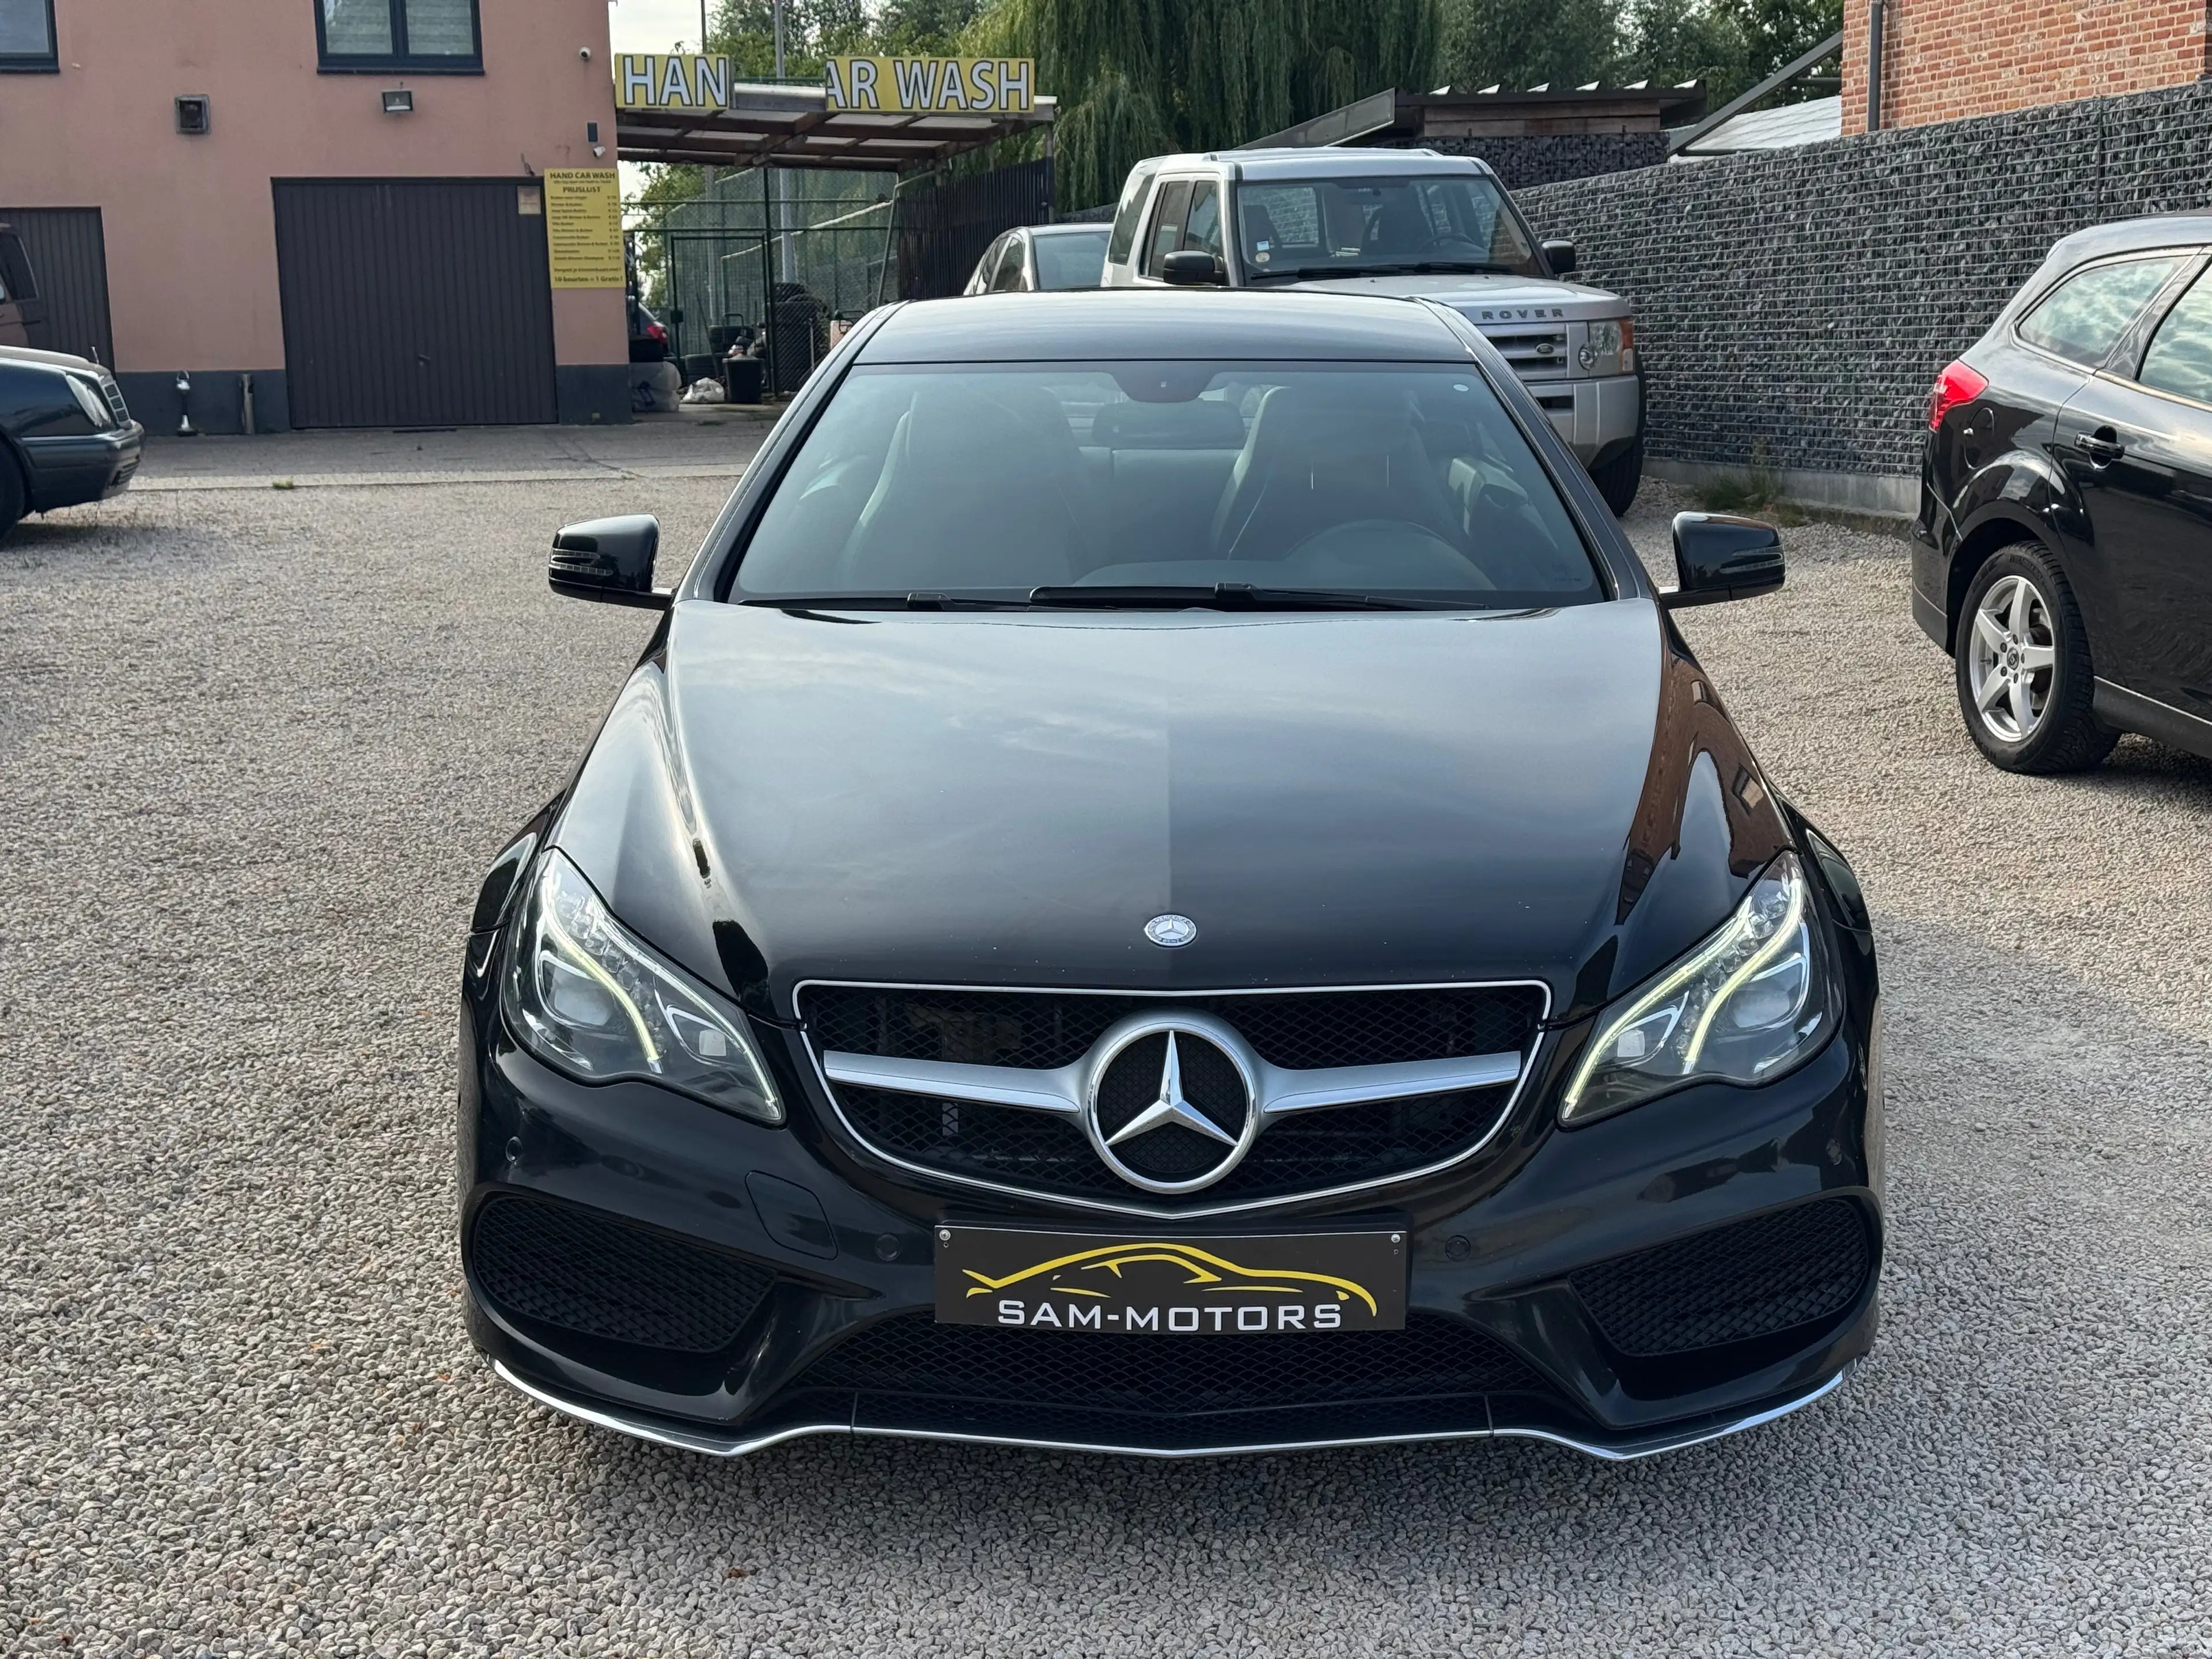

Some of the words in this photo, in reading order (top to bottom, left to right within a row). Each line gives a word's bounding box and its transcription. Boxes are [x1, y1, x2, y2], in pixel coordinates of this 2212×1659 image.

[893, 59, 1029, 111] WASH
[1482, 308, 1564, 320] ROVER
[998, 1299, 1342, 1332] SAM-MOTORS
